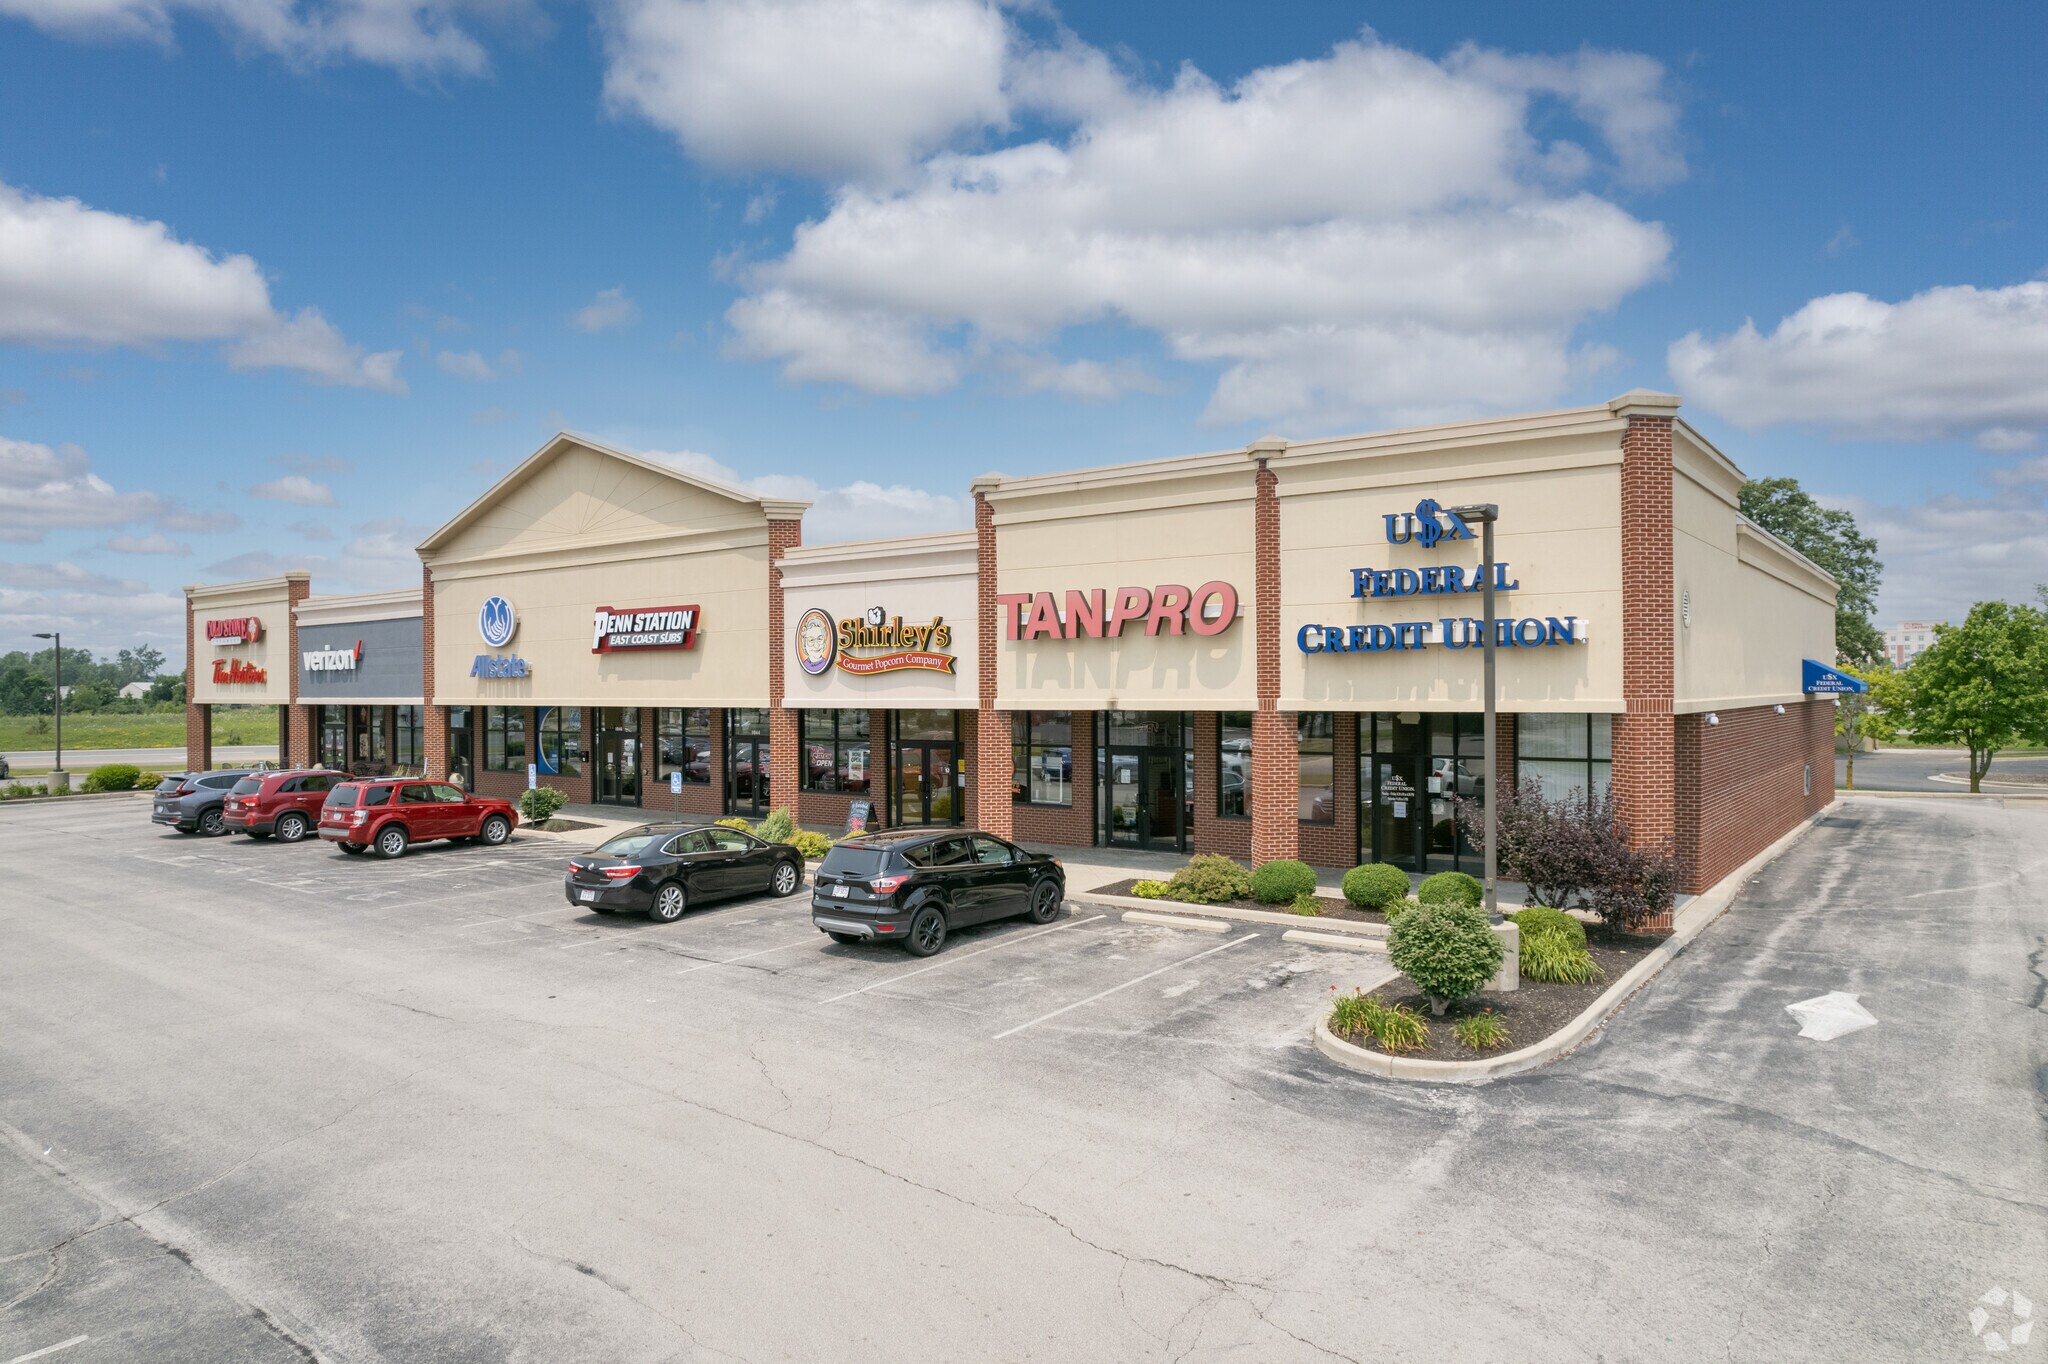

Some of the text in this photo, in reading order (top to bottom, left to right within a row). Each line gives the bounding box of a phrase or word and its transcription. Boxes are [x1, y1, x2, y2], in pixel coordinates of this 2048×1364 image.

[1350, 563, 1519, 598] FEDERAL
[205, 618, 247, 640] COLD STONE
[592, 611, 692, 649] PENN STATION
[610, 631, 682, 645] EAST COAST SUBS
[838, 616, 951, 651] Shirley's
[1297, 616, 1578, 654] CREDIT UNION
[212, 658, 230, 684] Tim
[303, 645, 356, 671] verizon
[470, 654, 526, 677] Allstate
[843, 654, 942, 671] Gourmet Popcorn Company
